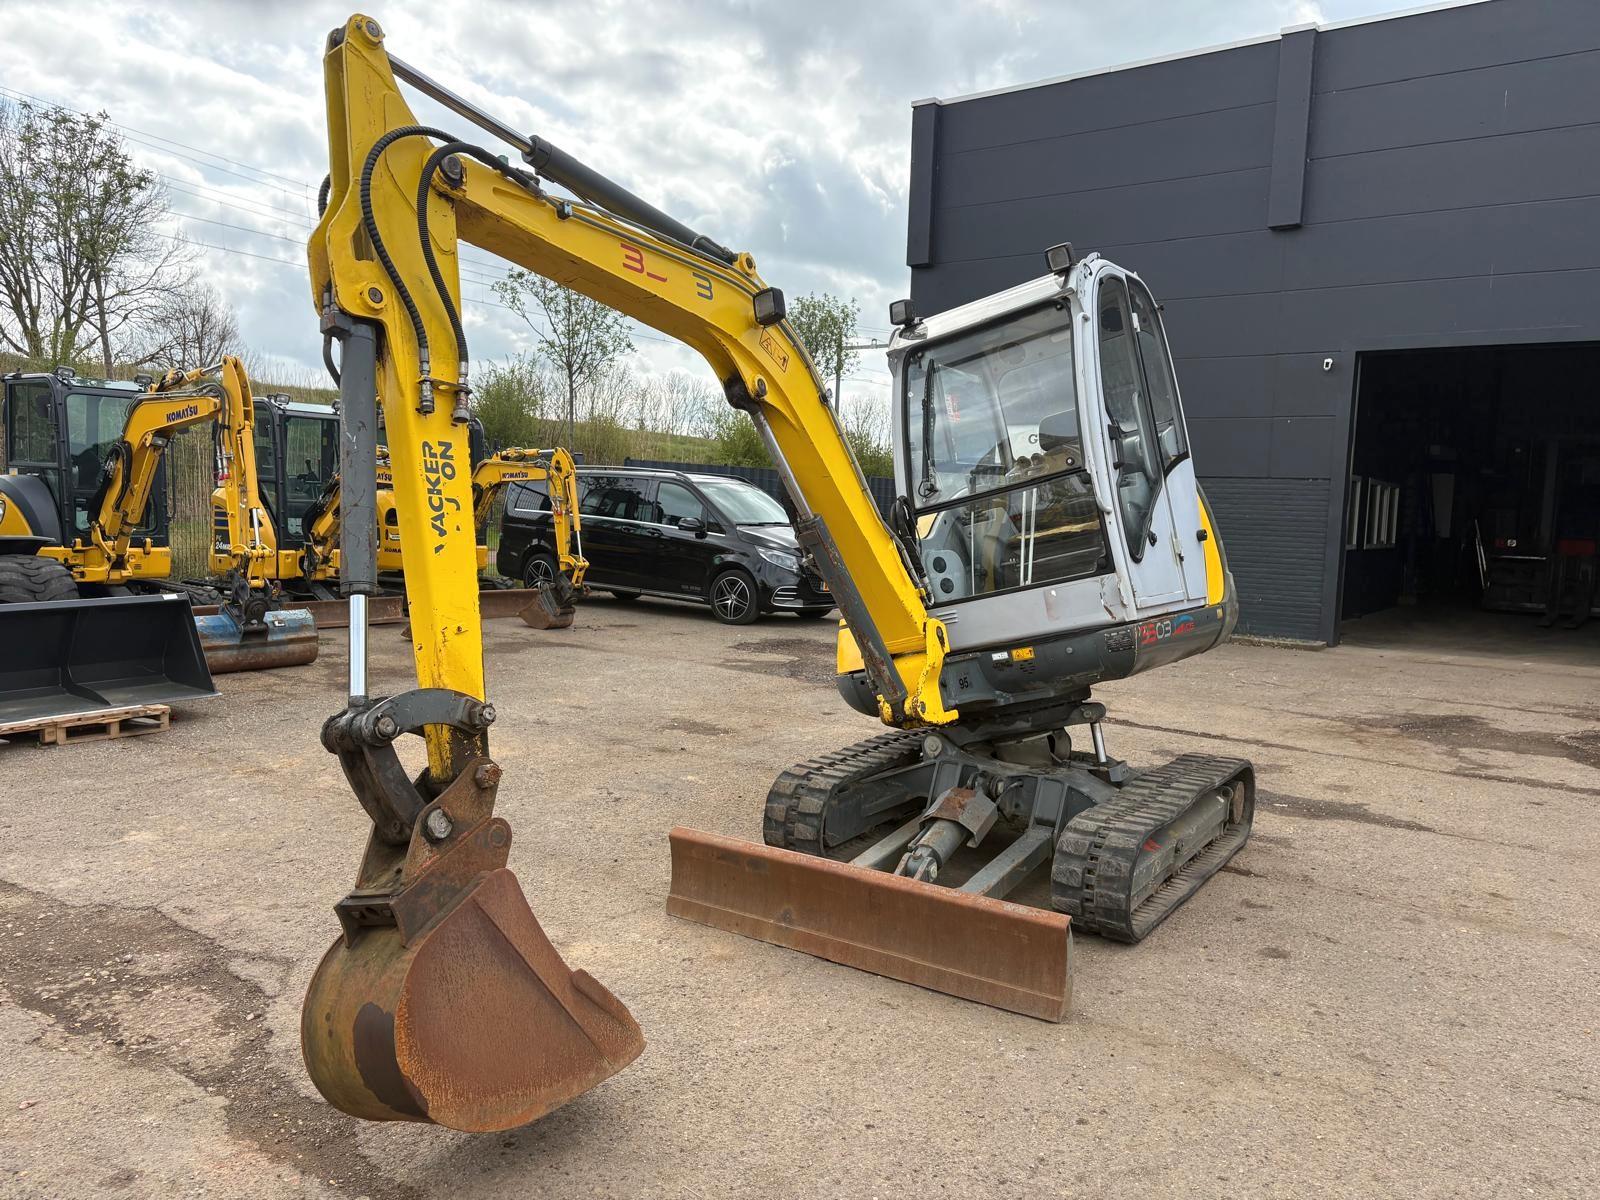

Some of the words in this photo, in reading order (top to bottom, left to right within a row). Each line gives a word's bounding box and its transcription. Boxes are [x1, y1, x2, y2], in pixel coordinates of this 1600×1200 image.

[166, 403, 198, 423] KOMATSU
[377, 472, 392, 481] ATSU
[502, 471, 528, 479] KOMATSU
[958, 676, 968, 689] 95
